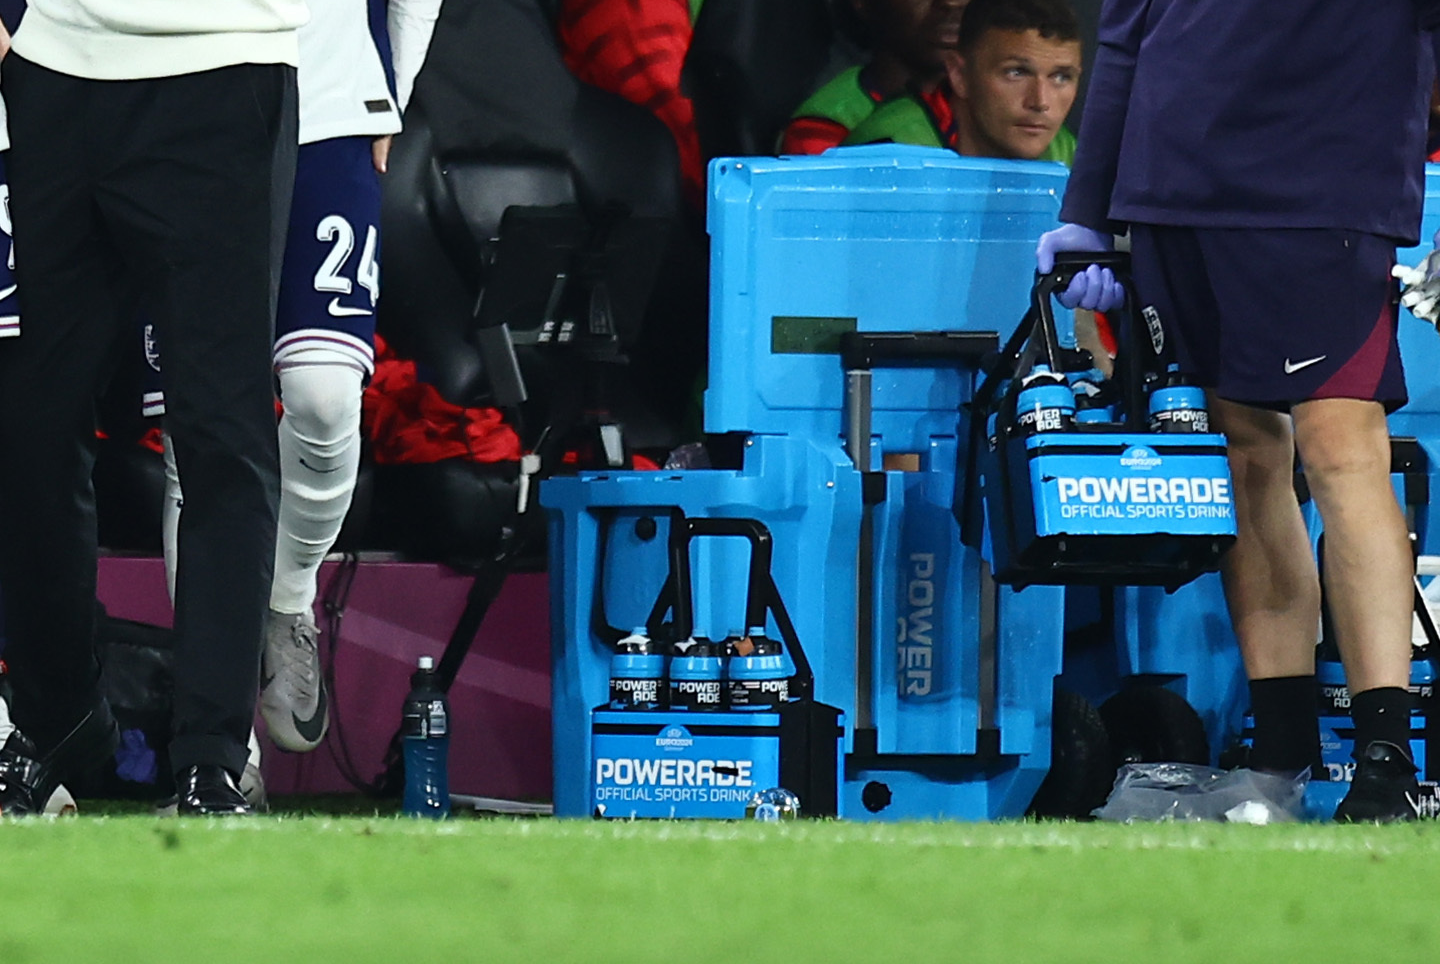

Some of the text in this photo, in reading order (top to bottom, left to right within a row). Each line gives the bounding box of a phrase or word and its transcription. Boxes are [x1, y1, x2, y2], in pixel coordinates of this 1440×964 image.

[313, 213, 380, 308] 24
[1020, 407, 1060, 425] POWER
[1036, 419, 1062, 432] ADE
[1057, 477, 1230, 504] POWERADE
[1061, 505, 1231, 519] OFFICIAL SPORTS DRINK
[907, 553, 935, 696] POWER
[615, 680, 658, 692] POWER
[679, 681, 721, 694] POWER
[761, 680, 789, 693] POWE
[633, 690, 658, 702] ADE
[697, 692, 721, 703] ADE
[1333, 697, 1352, 708] AD
[595, 758, 753, 787] POWERADE
[595, 787, 751, 802] OFFICIAL SPORTS DRINK
